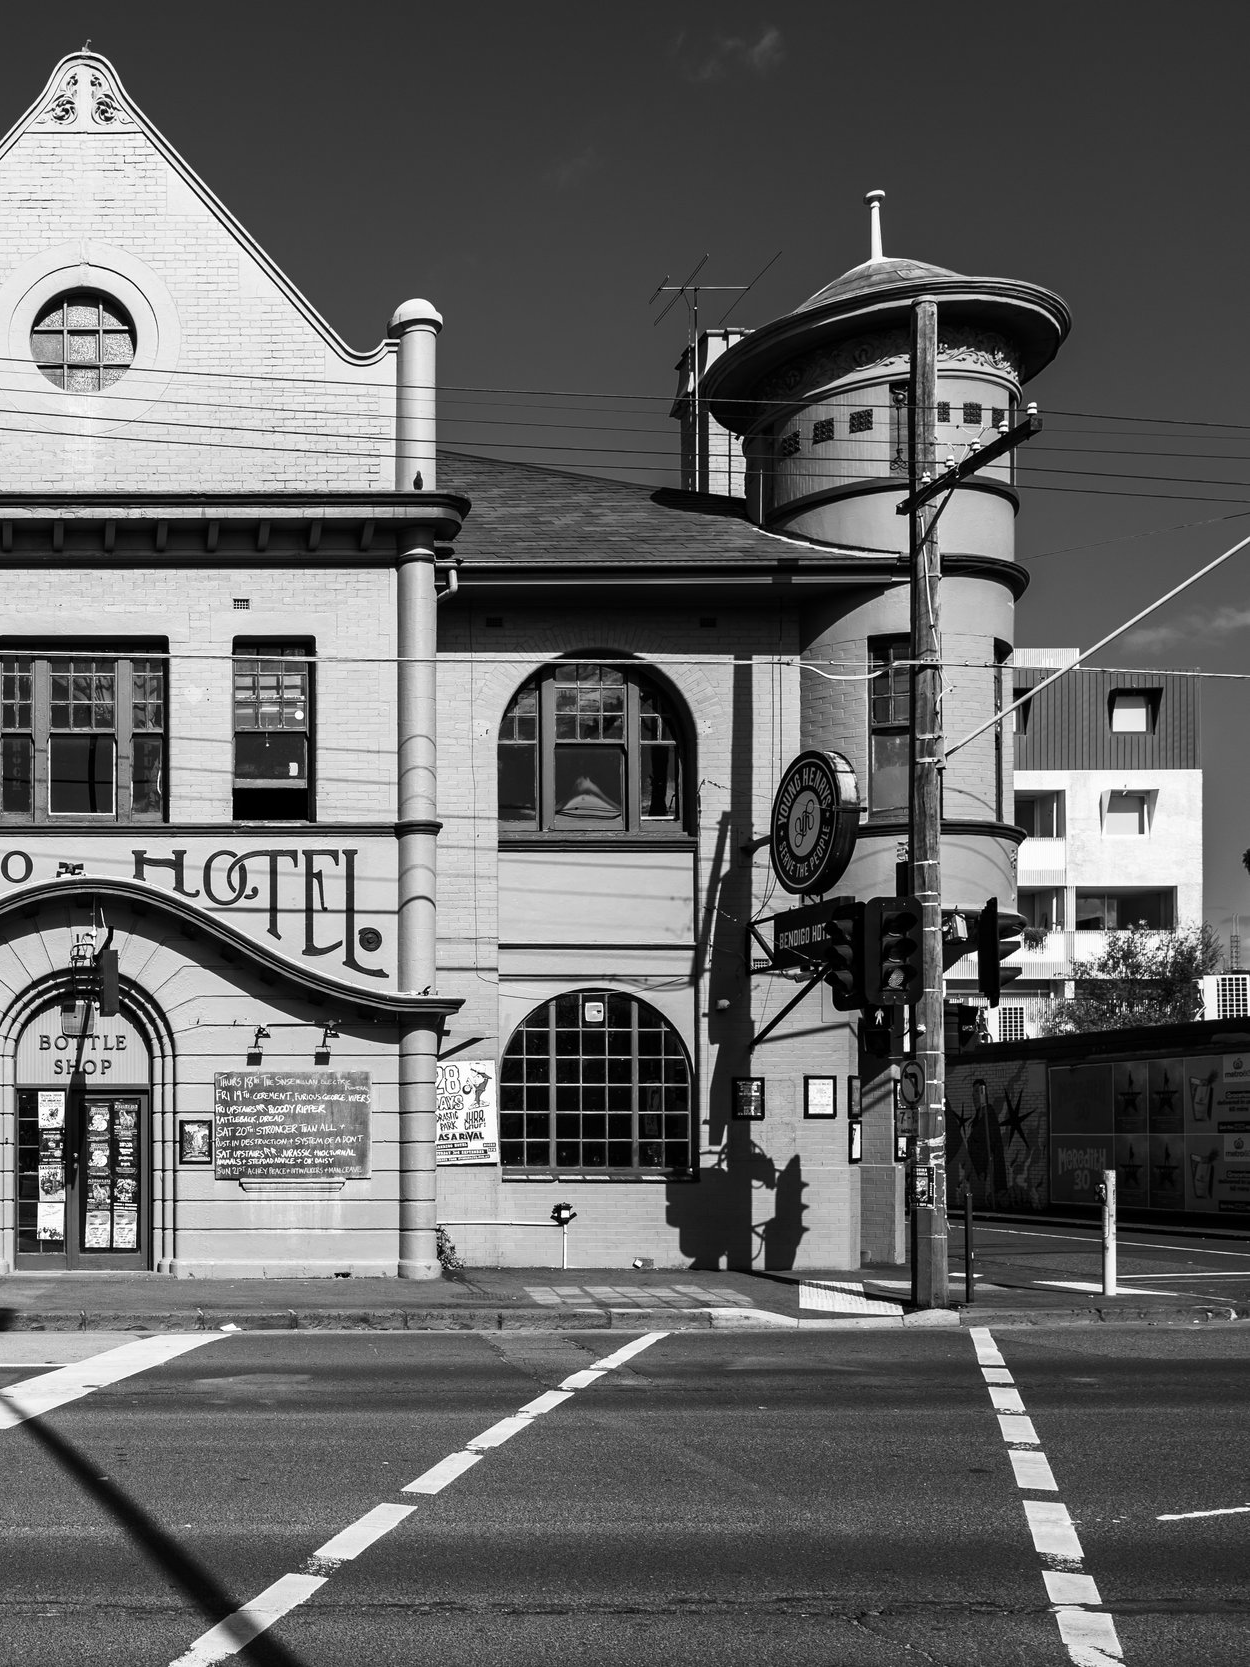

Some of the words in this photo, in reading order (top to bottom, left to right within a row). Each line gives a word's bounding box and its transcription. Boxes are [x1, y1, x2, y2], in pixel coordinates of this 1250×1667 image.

[778, 774, 802, 825] YOUNG
[802, 767, 832, 808] HENRYS
[778, 841, 796, 876] SERVE
[796, 862, 809, 878] THE
[809, 825, 831, 870] PEOPLE
[779, 927, 810, 950] BENDIGO
[39, 1035, 127, 1051] BOTTLE
[54, 1059, 112, 1075] SHOP
[217, 1074, 242, 1088] THURS
[436, 1065, 461, 1095] 28
[216, 1089, 231, 1101] FRI
[295, 1092, 321, 1101] FURIOUS
[436, 1094, 464, 1110] AYS
[226, 1105, 257, 1114] UPSTAIRS
[268, 1104, 295, 1114] BLOODY
[296, 1104, 326, 1114] RIPPER
[260, 1114, 285, 1123] DREAD
[440, 1120, 458, 1131] PARK
[216, 1126, 234, 1137] SAT
[256, 1124, 298, 1136] STRONGER
[299, 1124, 318, 1132] THAN
[319, 1123, 337, 1132] ALL
[438, 1133, 450, 1141] AS
[450, 1132, 458, 1140] A
[458, 1131, 484, 1142] RIVAL
[240, 1138, 288, 1146] DESTRUCTION
[295, 1136, 324, 1145] SYSTEM
[324, 1136, 334, 1144] OF
[216, 1149, 232, 1158] SAT
[233, 1150, 265, 1158] UPSTAIRS
[217, 1166, 232, 1176] SUN
[1073, 1169, 1091, 1191] 30
